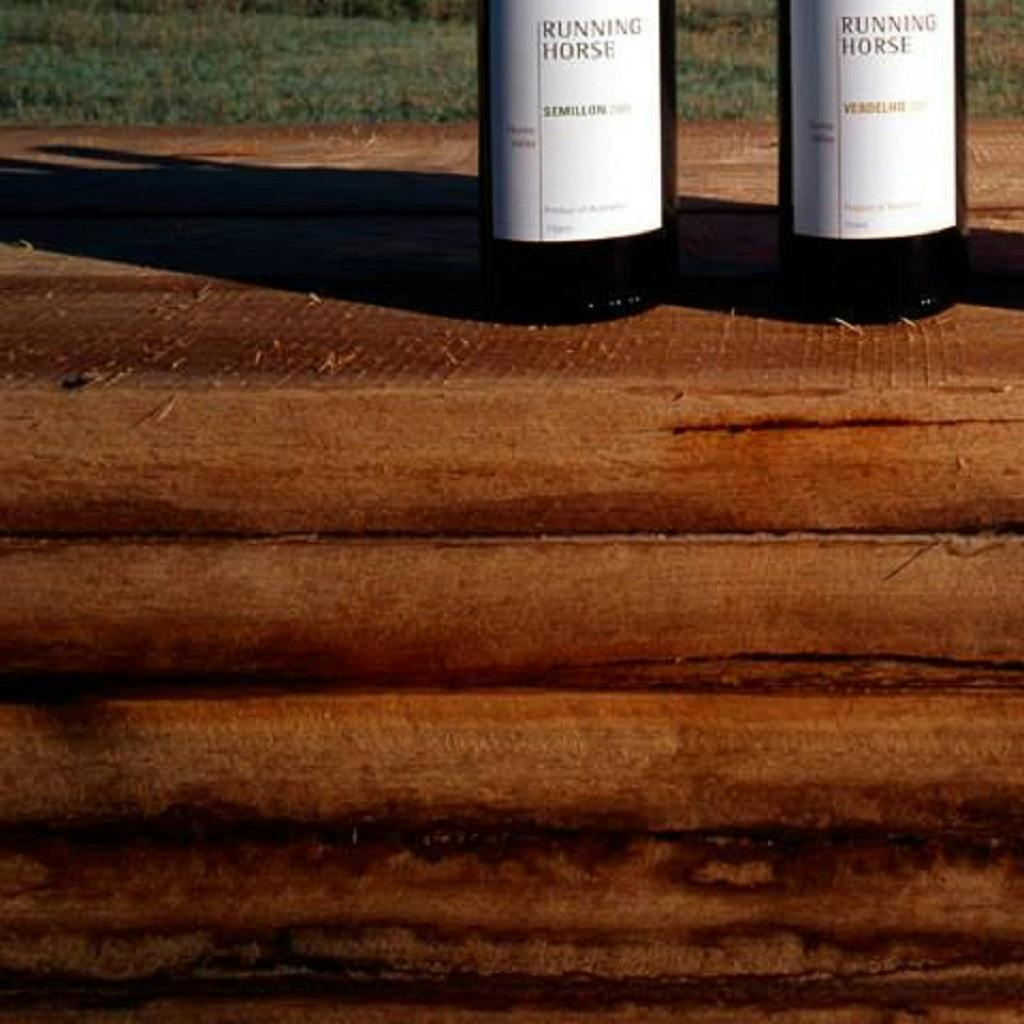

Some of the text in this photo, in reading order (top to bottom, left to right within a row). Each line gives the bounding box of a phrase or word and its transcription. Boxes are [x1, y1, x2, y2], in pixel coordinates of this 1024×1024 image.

[543, 17, 642, 38] RUNNING
[841, 14, 937, 34] RUNNING
[543, 40, 616, 60] HORSE
[841, 35, 912, 56] HORSE
[543, 104, 607, 118] SEMILLON
